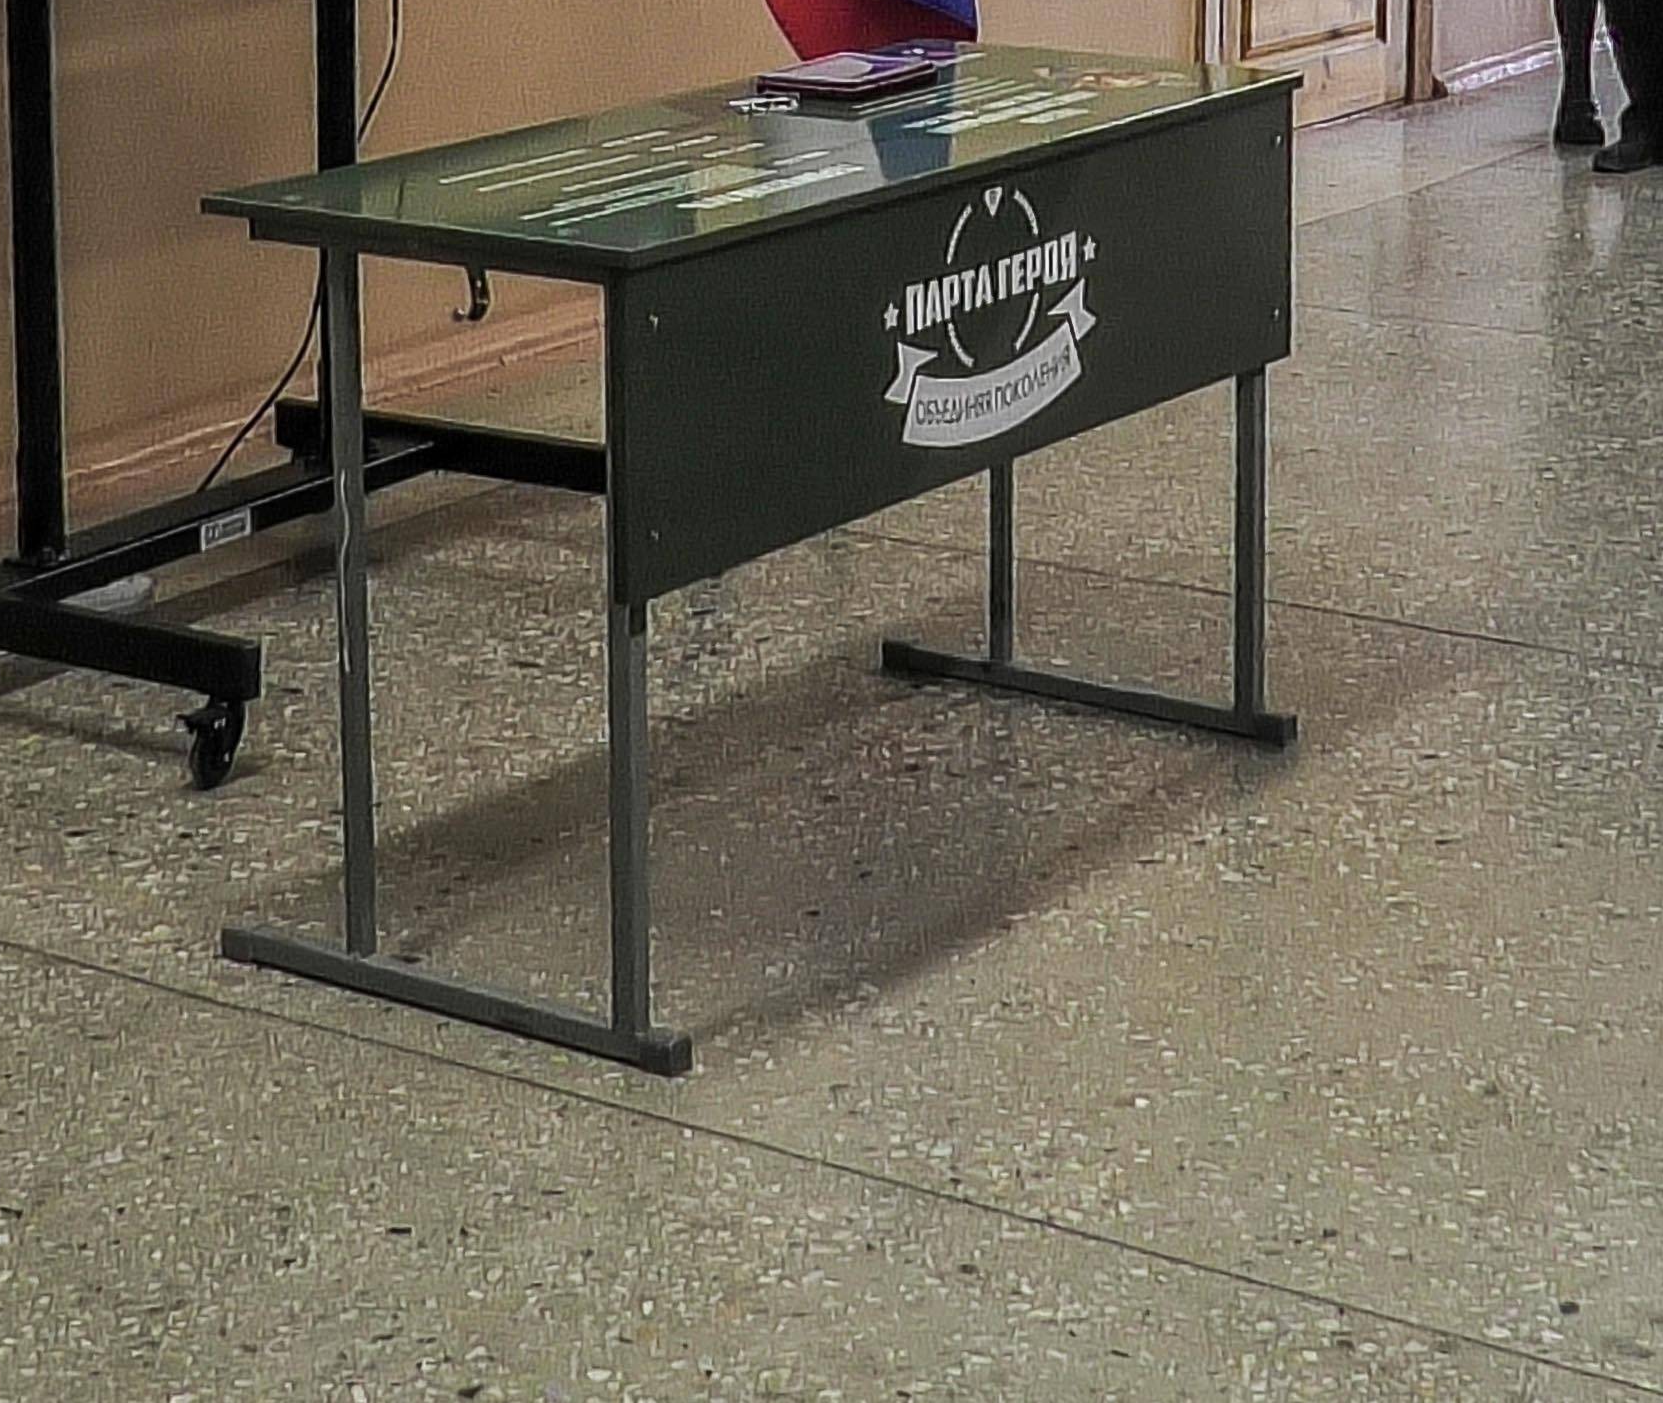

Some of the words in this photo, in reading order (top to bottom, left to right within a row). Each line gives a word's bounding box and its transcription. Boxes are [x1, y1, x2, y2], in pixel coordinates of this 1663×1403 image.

[905, 264, 994, 336] ПАРТА
[997, 230, 1078, 300] ГЕРОЯ
[916, 389, 992, 426] ОБЪЕДИНЯЯ
[995, 343, 1072, 412] ПОКОЛЕНИЯ
